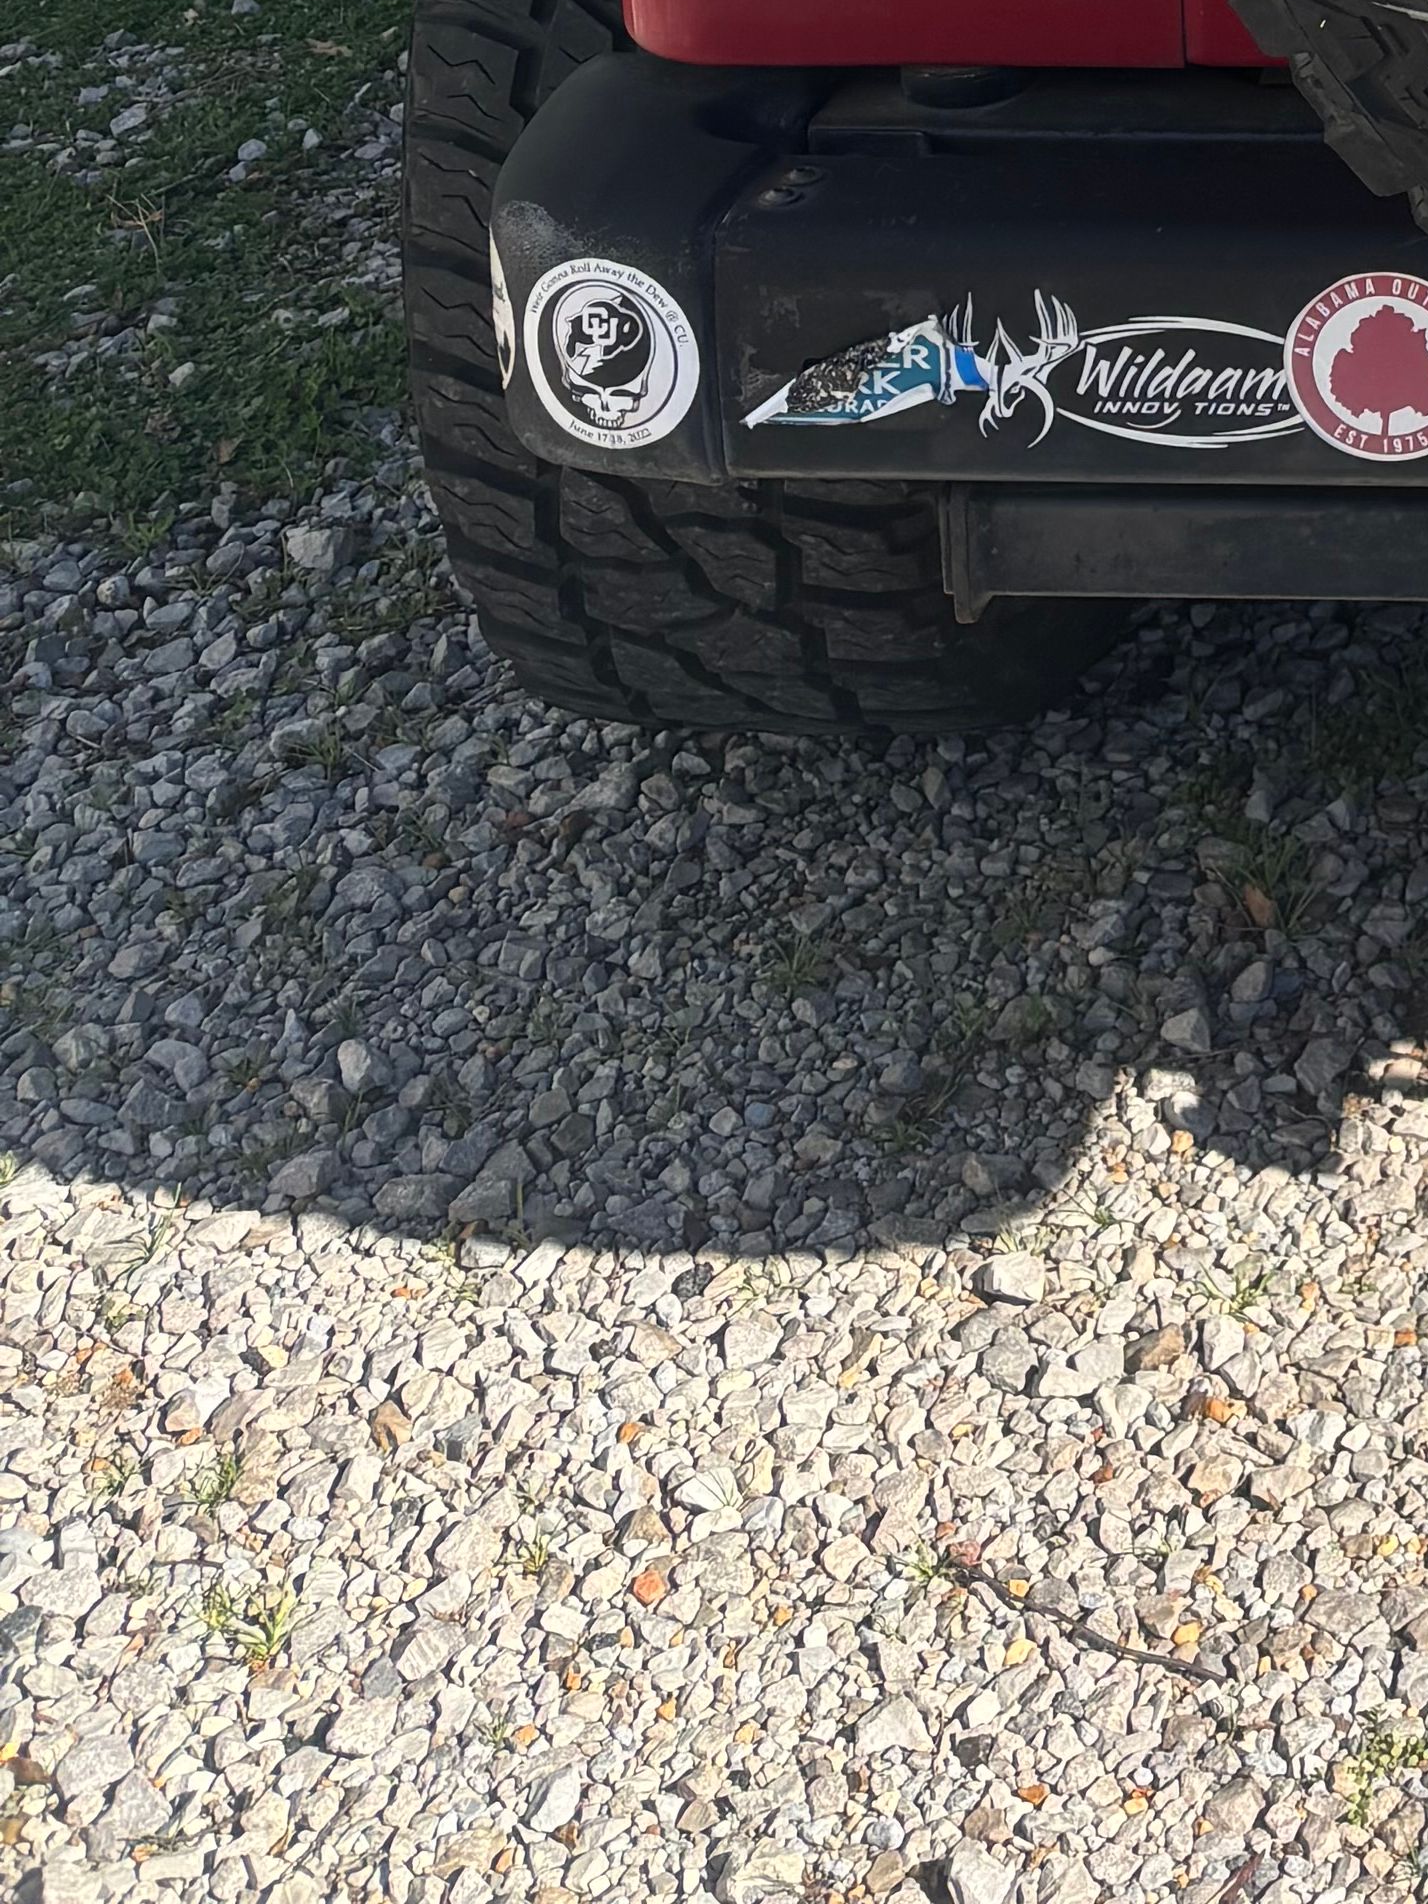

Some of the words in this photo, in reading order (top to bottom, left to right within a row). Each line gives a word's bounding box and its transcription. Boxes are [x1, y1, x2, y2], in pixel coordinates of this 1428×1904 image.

[570, 262, 591, 275] Roll
[593, 263, 625, 280] Away
[627, 272, 645, 288] the
[645, 284, 669, 309] Dew
[1294, 278, 1376, 357] ALABAMA
[568, 419, 594, 440] June
[1333, 423, 1369, 450] EST
[1383, 431, 1428, 454] 1975
